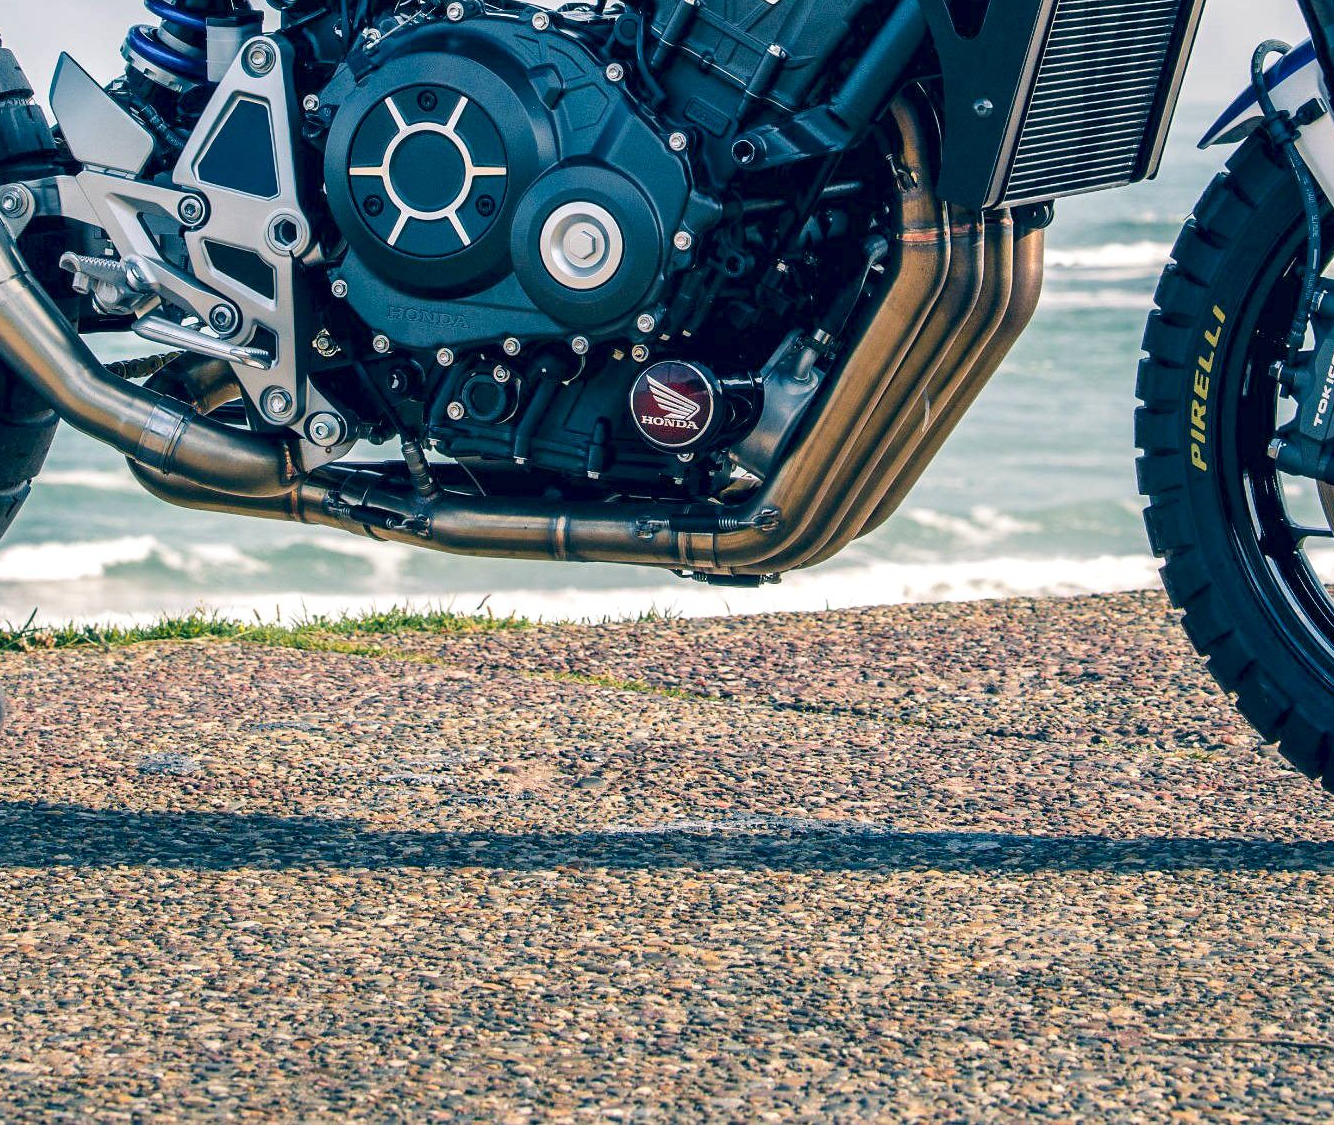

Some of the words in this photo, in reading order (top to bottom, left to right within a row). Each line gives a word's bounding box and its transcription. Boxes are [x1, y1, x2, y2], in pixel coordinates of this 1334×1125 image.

[388, 306, 470, 329] HONDA
[1190, 307, 1226, 471] PIRELLI
[640, 415, 700, 431] HONDA
